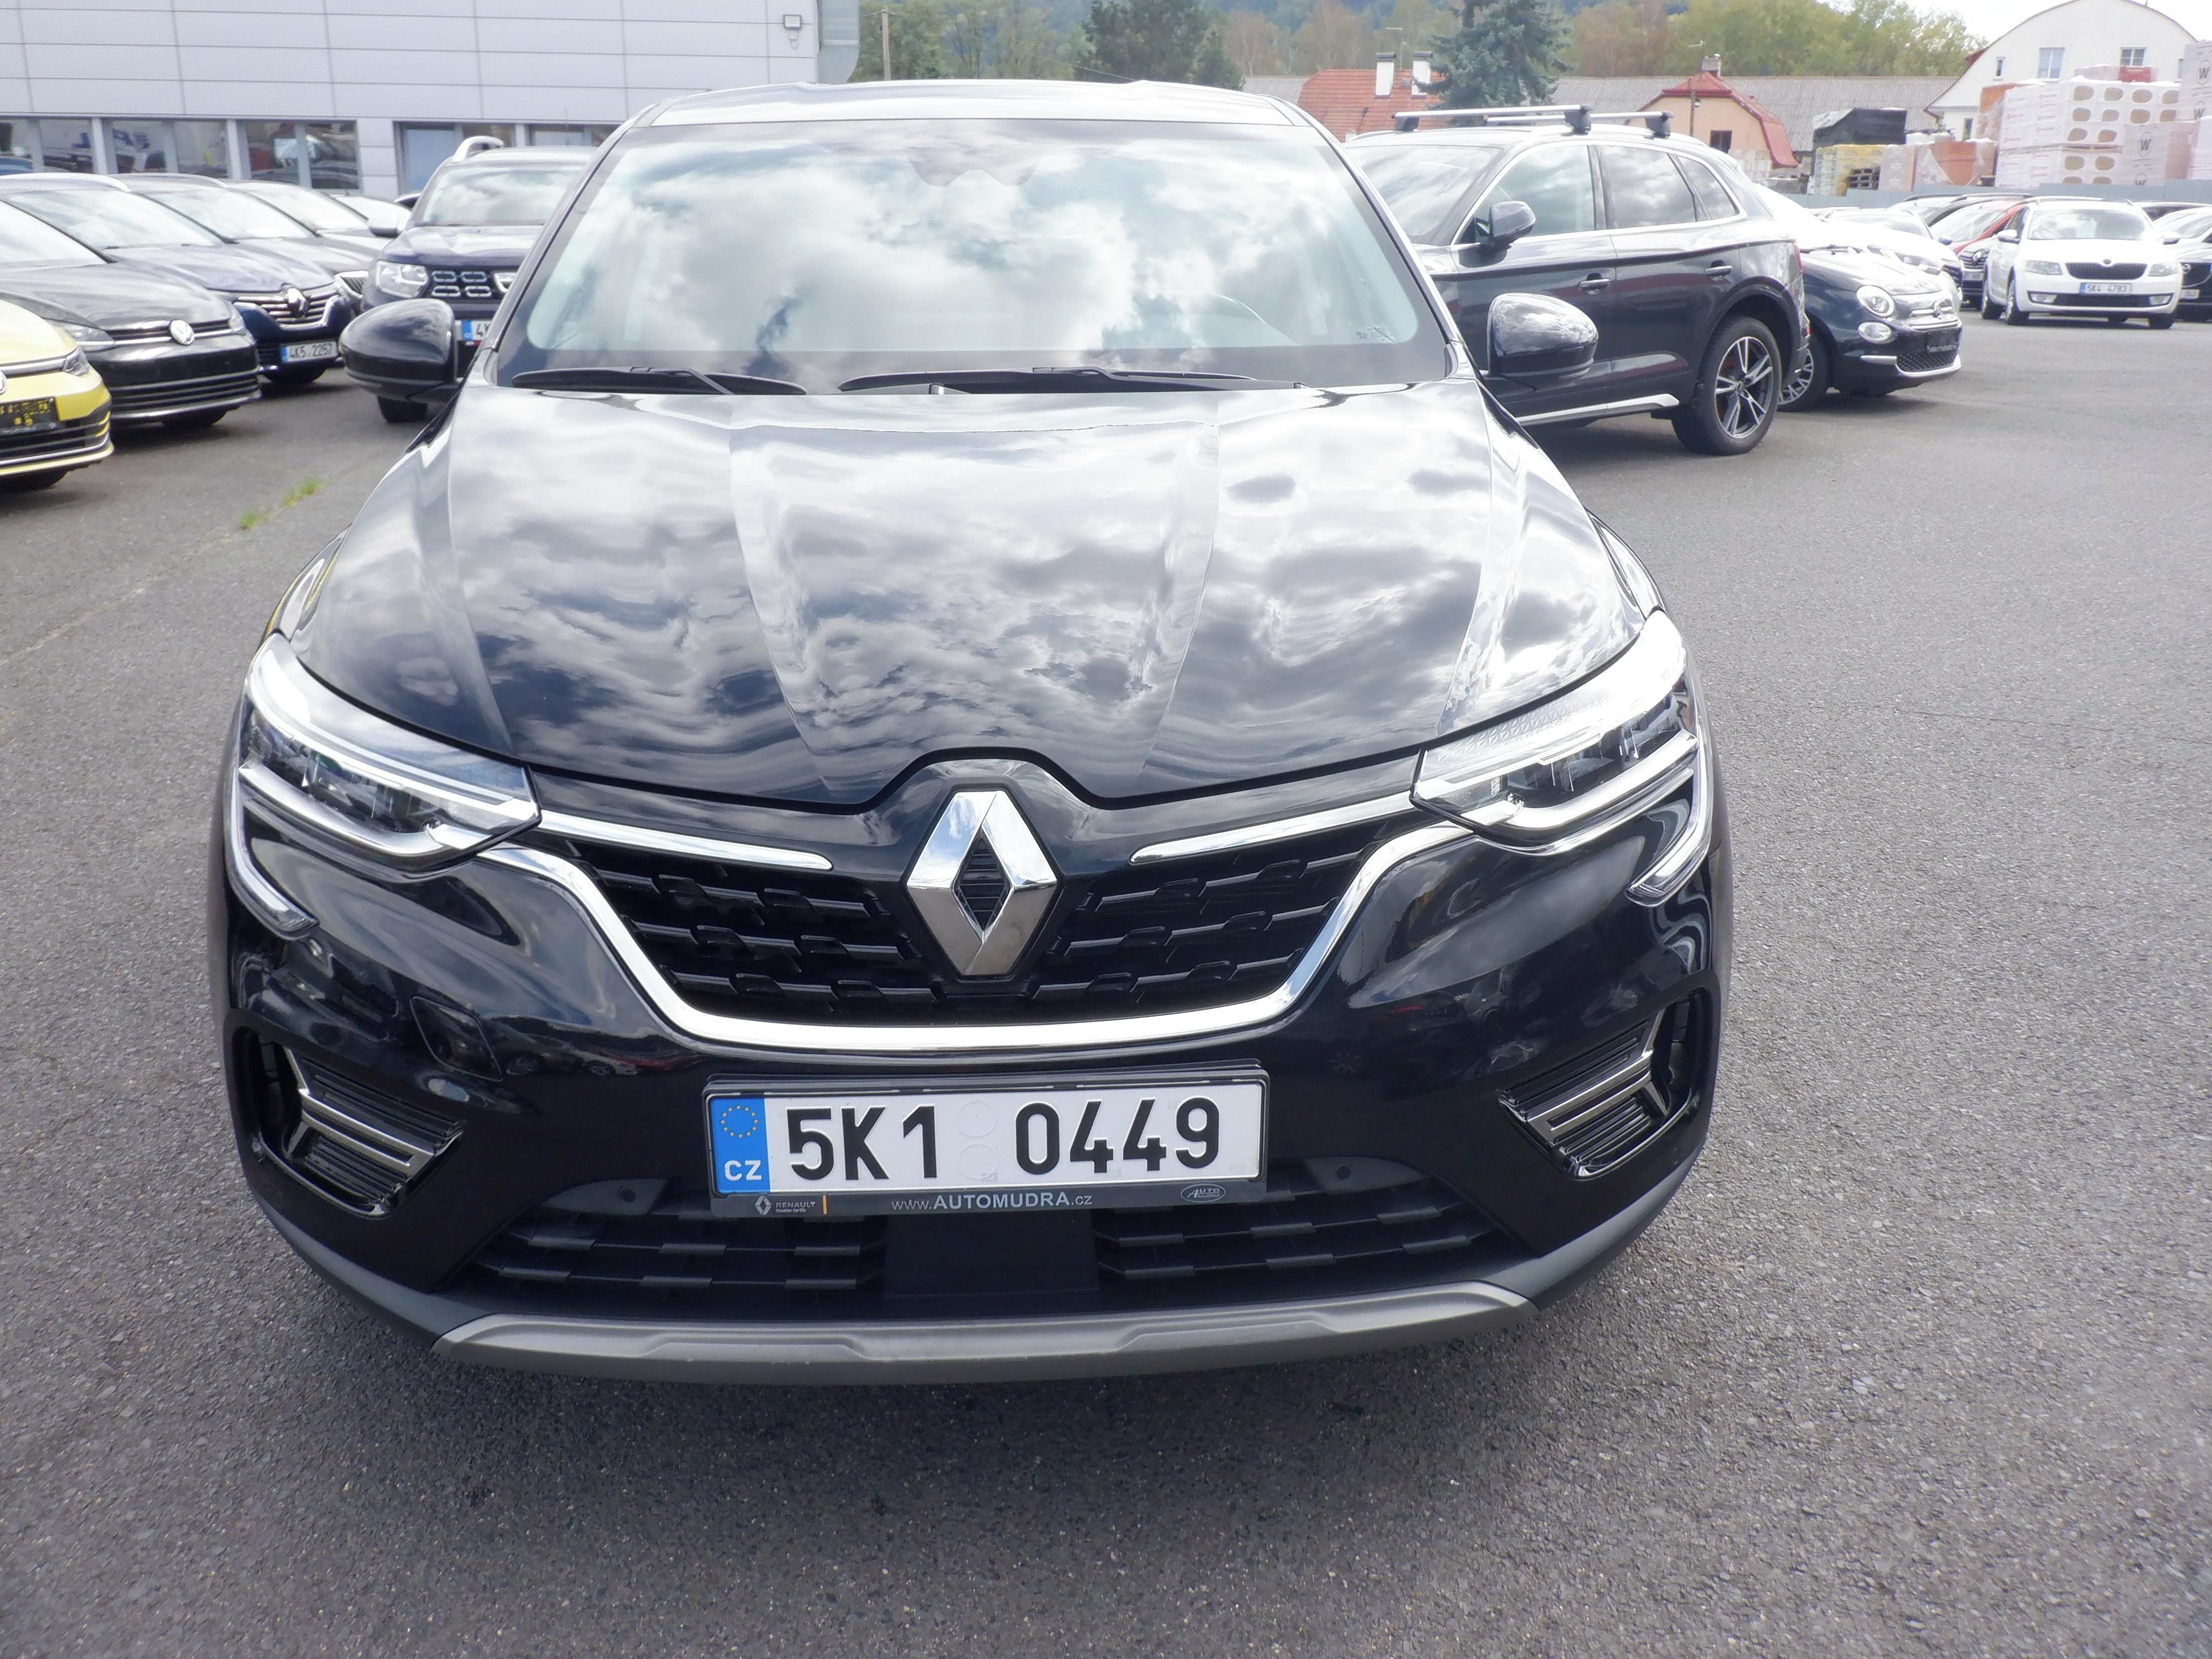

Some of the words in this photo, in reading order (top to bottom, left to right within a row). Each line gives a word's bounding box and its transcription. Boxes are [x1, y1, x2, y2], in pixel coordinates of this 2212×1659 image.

[786, 1105, 938, 1181] 5K1
[1015, 1097, 1219, 1175] 0449
[724, 1159, 762, 1181] CZ
[891, 1192, 1092, 1211] www.AUTOMUDRA.cz
